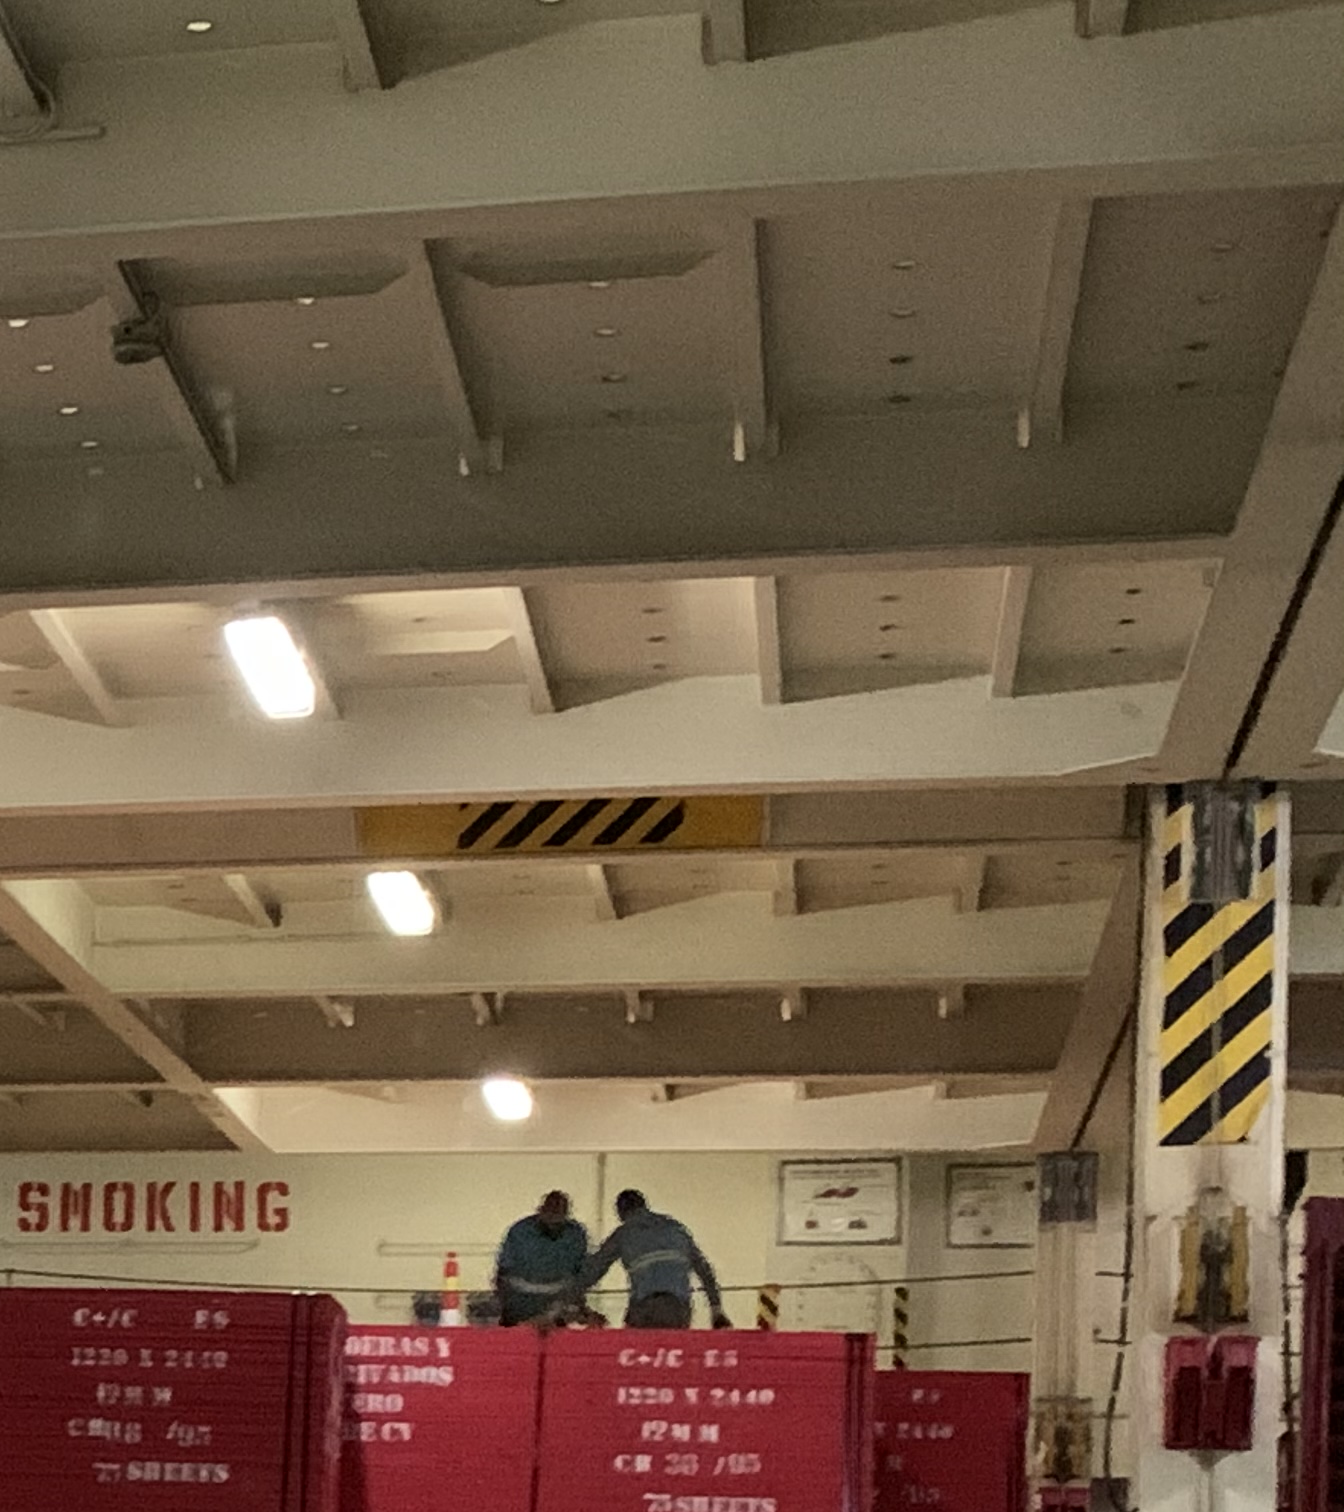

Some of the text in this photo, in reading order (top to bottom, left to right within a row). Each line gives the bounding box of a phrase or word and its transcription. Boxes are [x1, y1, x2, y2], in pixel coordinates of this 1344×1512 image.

[16, 1180, 292, 1234] SMOKING
[72, 1307, 231, 1330] C+/C ES
[344, 1335, 453, 1358] DERAS Y
[71, 1347, 229, 1369] 1220 X 2440
[618, 1349, 739, 1368] C+/C ES
[617, 1387, 675, 1405] 1220
[709, 1388, 775, 1408] 2440
[380, 1421, 414, 1443] CV
[614, 1453, 653, 1472] CR
